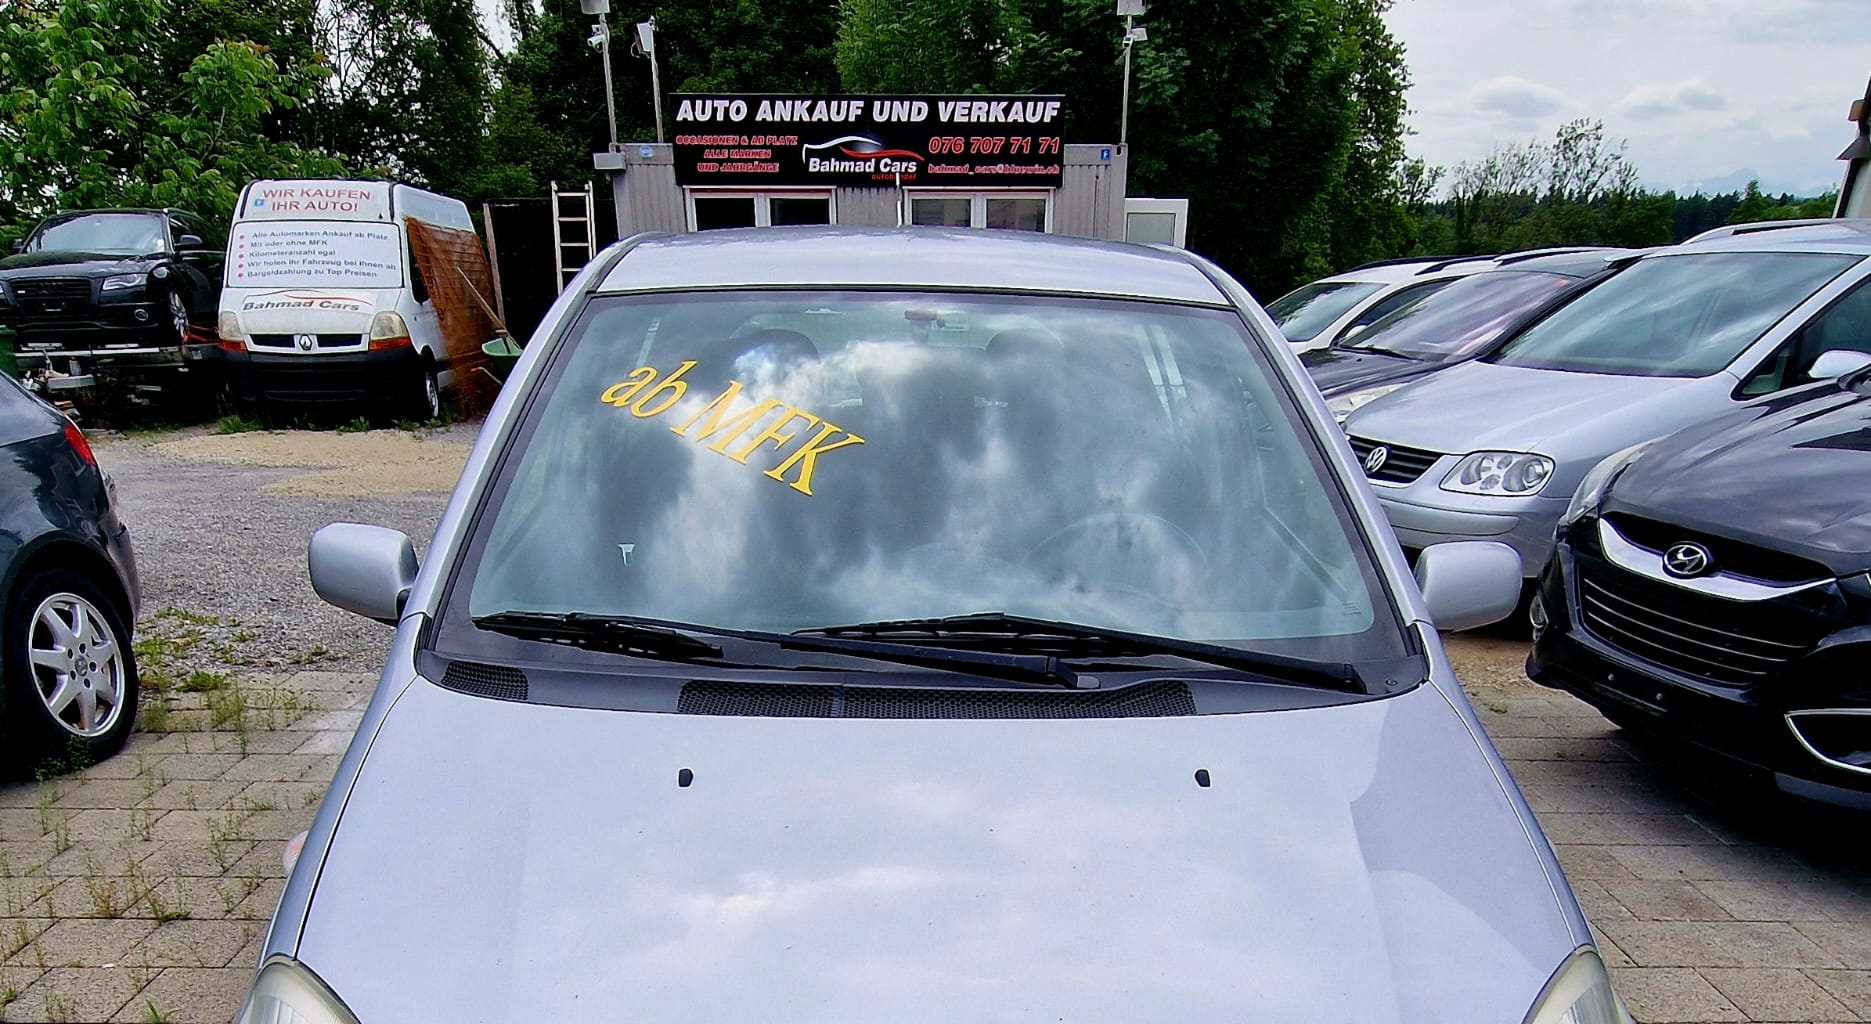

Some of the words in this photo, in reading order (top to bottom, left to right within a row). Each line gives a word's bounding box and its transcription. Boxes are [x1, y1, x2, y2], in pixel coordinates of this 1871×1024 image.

[676, 99, 748, 122] AUTO
[755, 99, 865, 122] ANKAUF
[872, 100, 929, 123] UND
[938, 100, 1061, 123] VERKAUF
[675, 134, 740, 146] OCCASIONEN
[740, 135, 749, 146] &
[766, 135, 799, 146] PLATZ
[928, 136, 965, 154] 076
[969, 136, 1004, 154] 707
[1009, 136, 1031, 154] 71
[1038, 136, 1060, 154] 71
[703, 149, 729, 159] ALLE
[729, 149, 772, 159] MARKEN
[697, 162, 719, 173] UND
[720, 161, 780, 173] JAHRGÄNGE
[808, 157, 876, 173] Bahmad
[879, 157, 917, 173] Cars
[263, 189, 295, 199] WIR
[300, 188, 371, 200] KAUFEN
[271, 201, 300, 211] IHR
[304, 201, 358, 212] AUTO!
[269, 230, 321, 238] Automarken
[367, 232, 388, 240] Platz
[249, 249, 316, 257] Kilometeranzahl
[317, 249, 336, 257] egal
[302, 258, 342, 267] Fahrzeug
[359, 260, 383, 269] Ihnen
[385, 263, 397, 271] ab
[247, 268, 312, 278] Bargeldzahlung
[327, 268, 342, 276] Top
[344, 268, 378, 278] Preisen
[243, 300, 314, 312] Bahmad
[318, 301, 360, 311] Cars
[600, 359, 698, 418] ab
[669, 379, 866, 497] MFK
